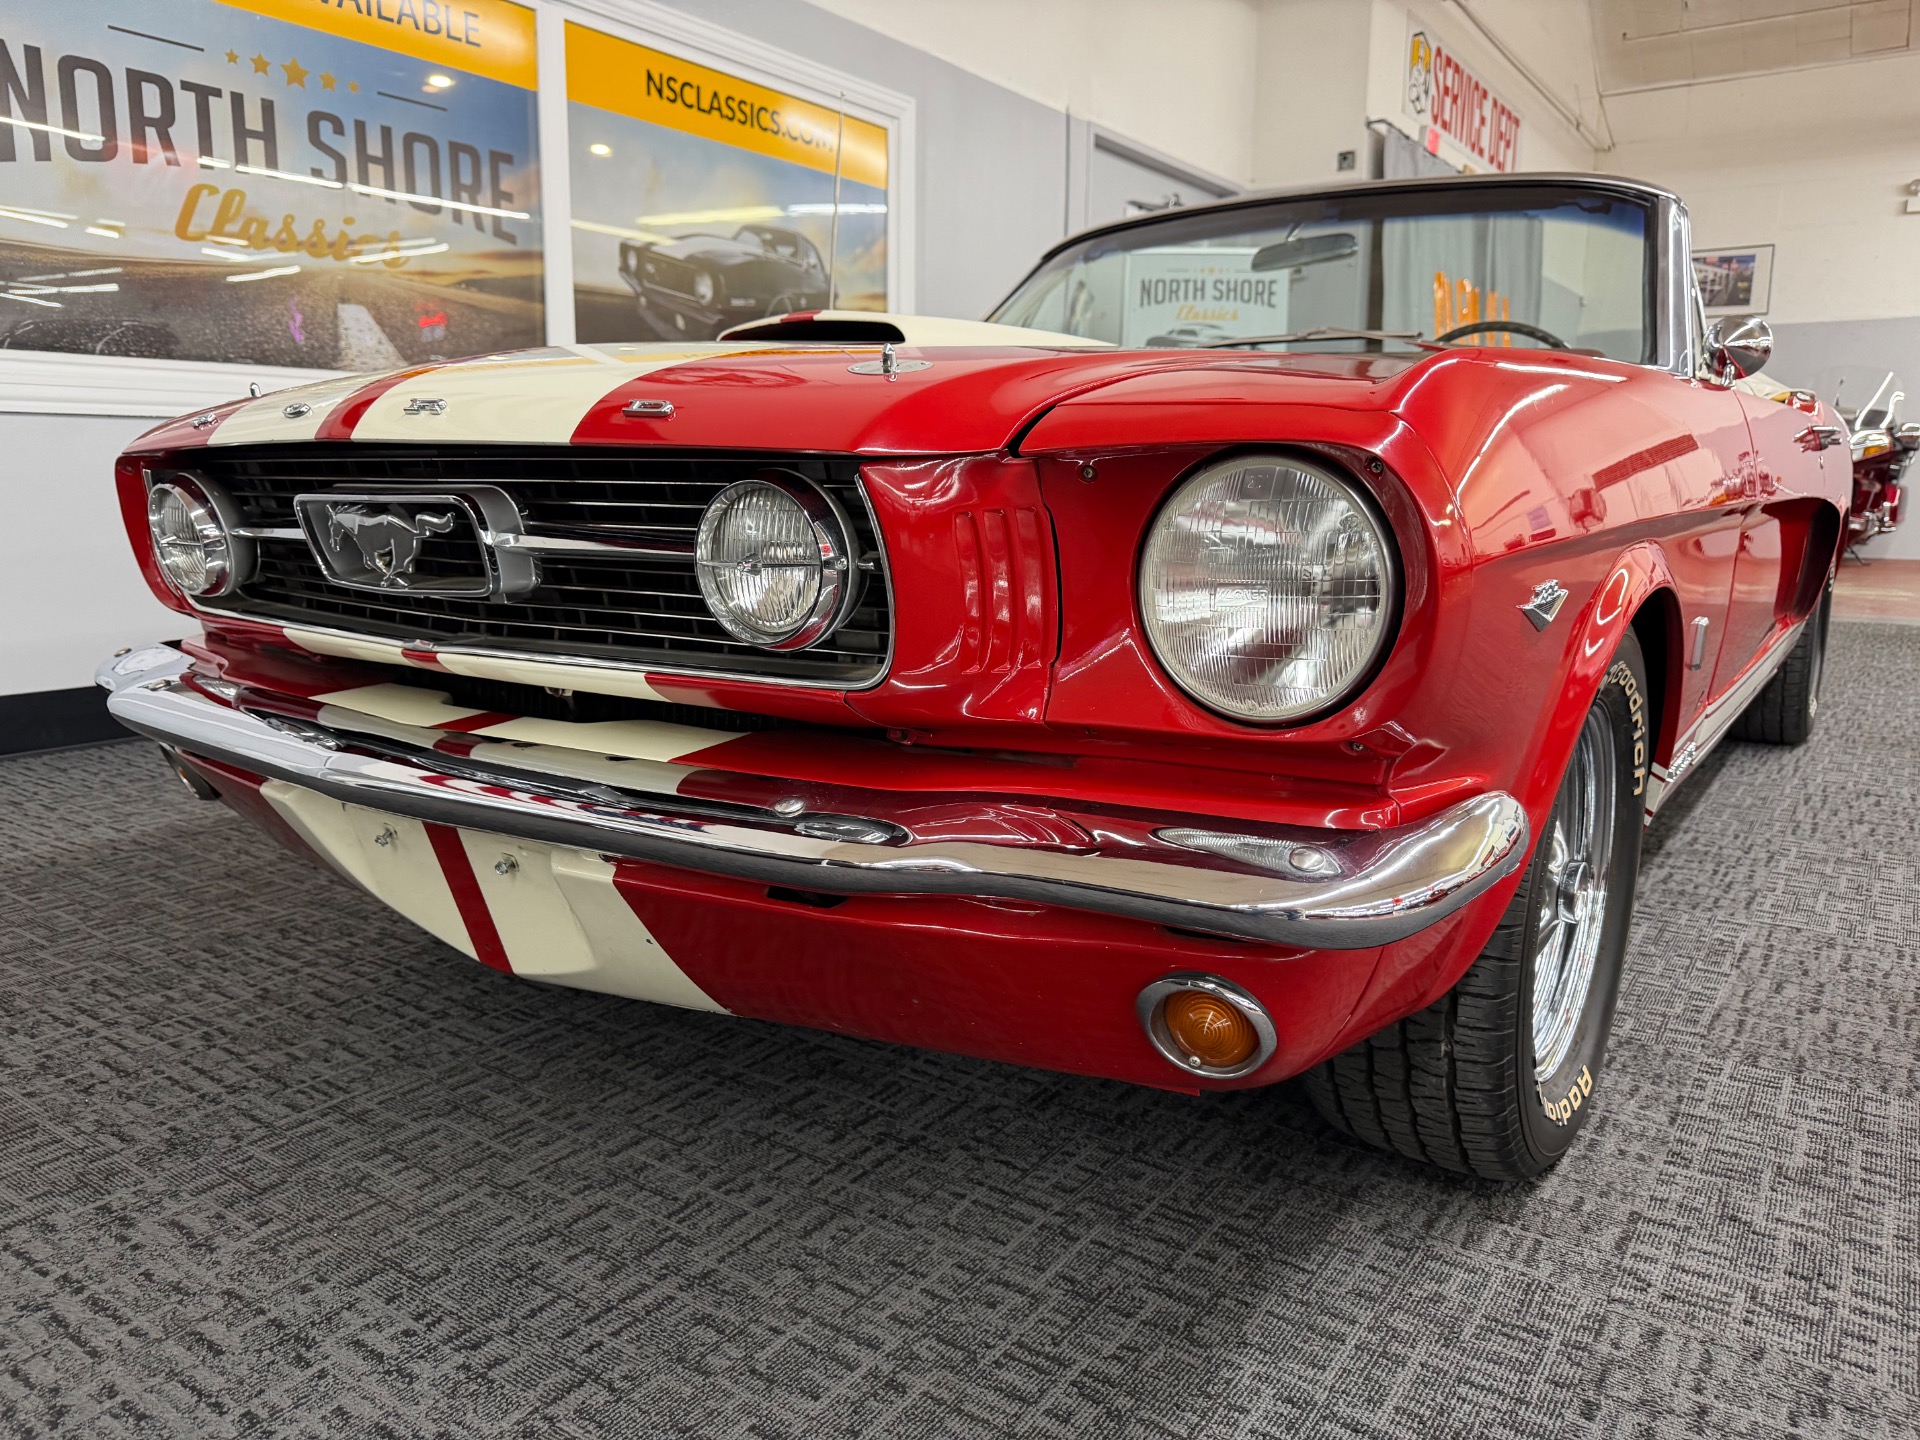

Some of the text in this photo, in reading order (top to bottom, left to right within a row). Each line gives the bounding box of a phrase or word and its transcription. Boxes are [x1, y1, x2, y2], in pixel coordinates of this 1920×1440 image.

[311, 0, 481, 47] ILABLE
[0, 38, 518, 245] NORTH SHORE
[645, 69, 835, 153] NSCLASSICS.CO
[1431, 46, 1520, 173] SERVICE DEPT
[174, 183, 411, 268] Classics
[1139, 277, 1277, 308] NORTH SHORE
